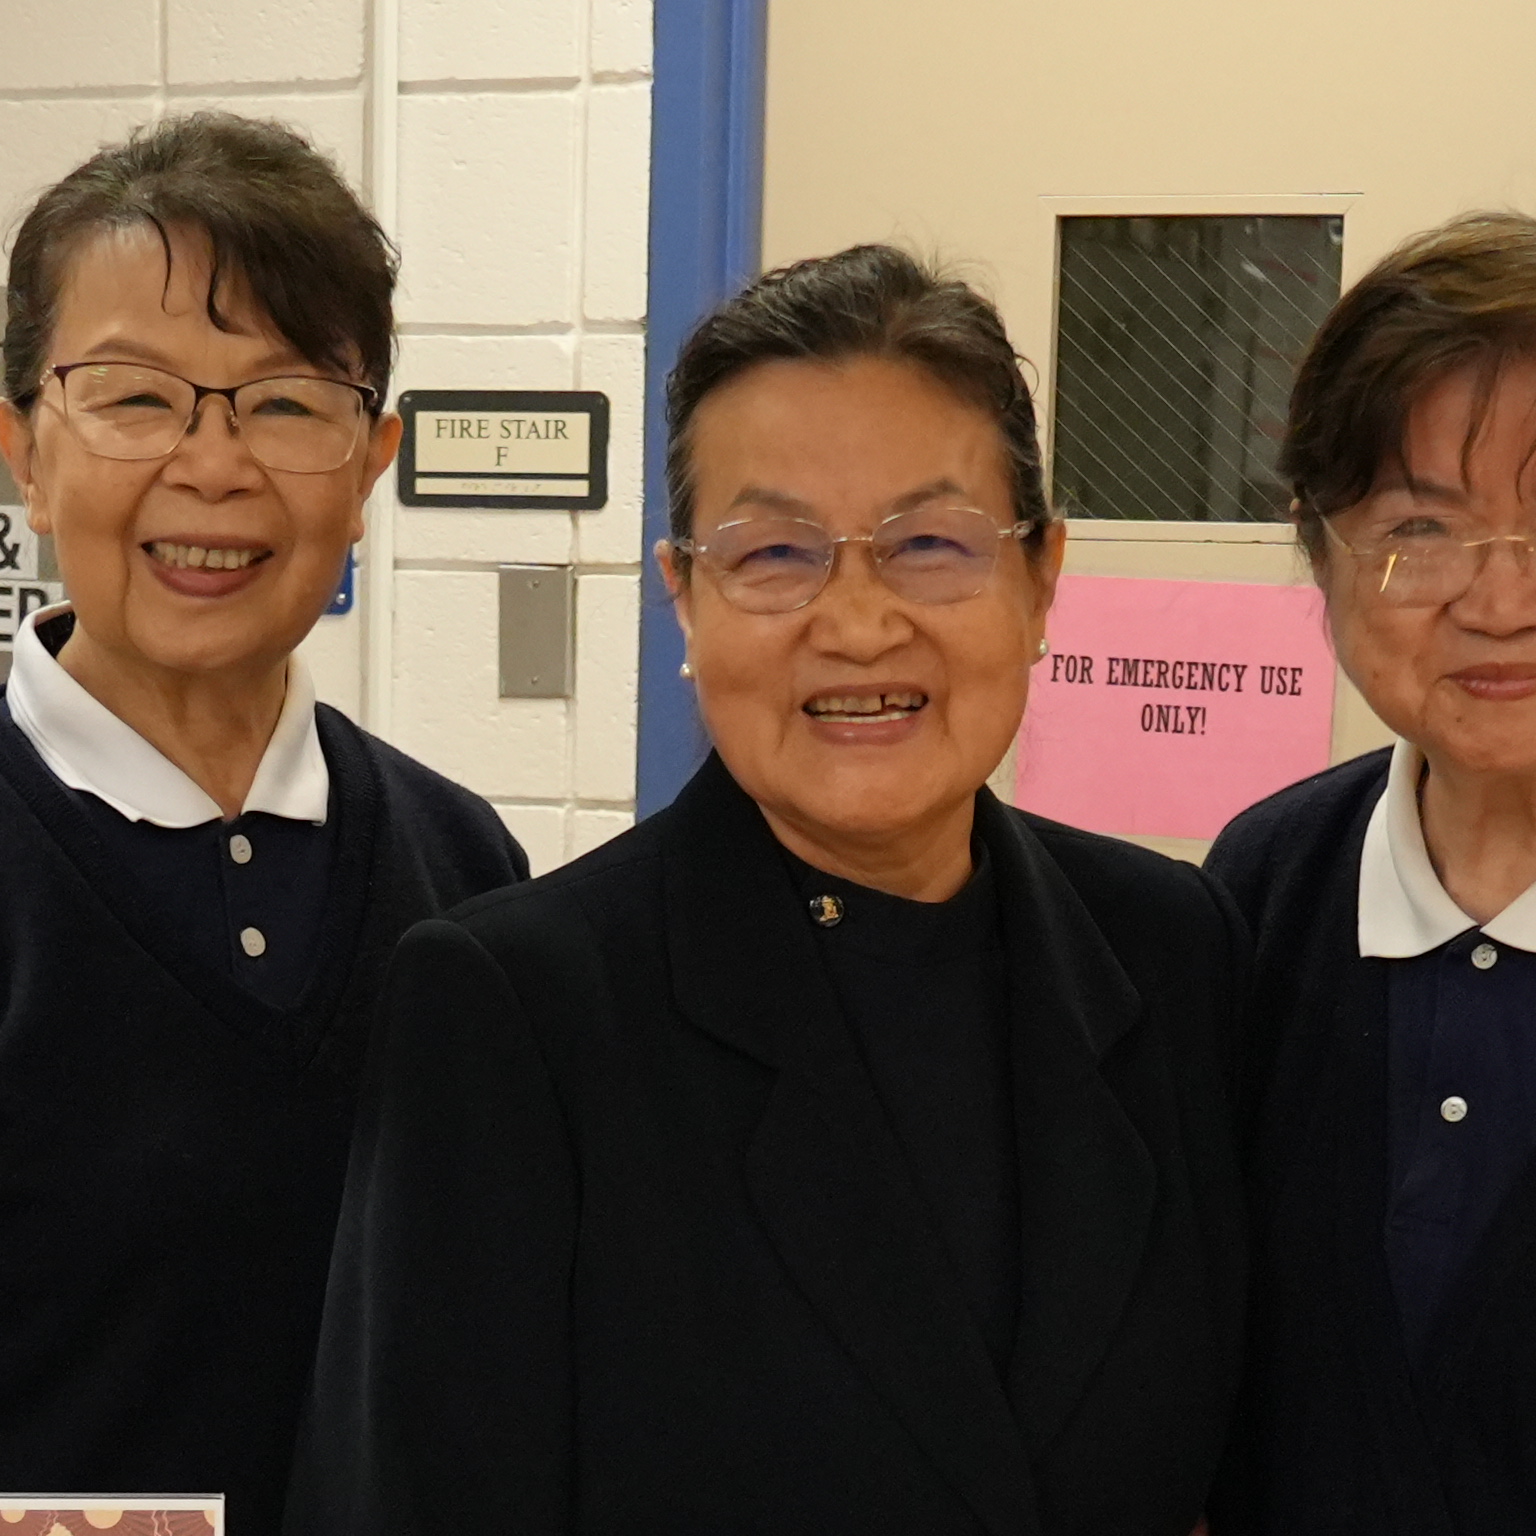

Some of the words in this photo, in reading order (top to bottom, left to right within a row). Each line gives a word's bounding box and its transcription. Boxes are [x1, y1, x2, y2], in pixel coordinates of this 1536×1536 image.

[436, 419, 491, 440] FIRE
[500, 419, 569, 440] STAIR
[495, 446, 509, 467] F
[1050, 654, 1094, 684] FOR
[1106, 657, 1248, 692] EMERGENCY
[1259, 666, 1303, 696] USE
[1140, 704, 1207, 735] ONLY!
